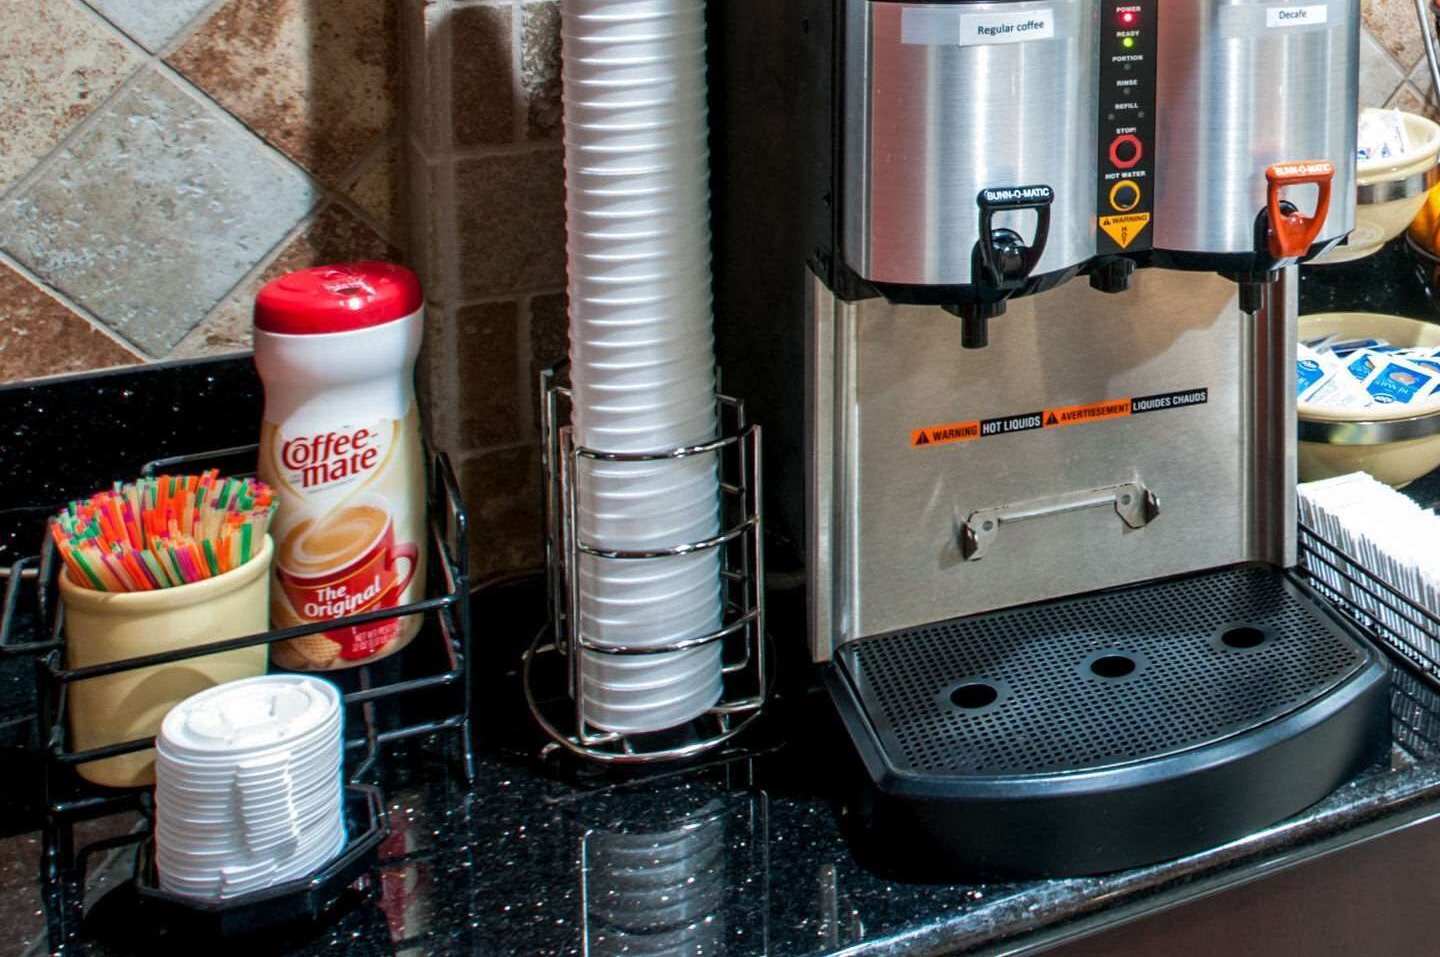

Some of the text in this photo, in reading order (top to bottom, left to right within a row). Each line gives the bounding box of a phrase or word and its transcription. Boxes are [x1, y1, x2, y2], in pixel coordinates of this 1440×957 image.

[1279, 9, 1307, 20] Decafe
[977, 20, 1045, 36] Regular coffee
[986, 187, 1050, 201] BUNN-O-MATIC
[1112, 214, 1148, 224] WARNING
[932, 392, 1206, 441] WARNING HOT LIQUIDS AVERTISSEMENT LIQUIDES CHAUDS
[302, 447, 377, 488] mate
[303, 574, 381, 619] Original
[316, 585, 346, 602] The
